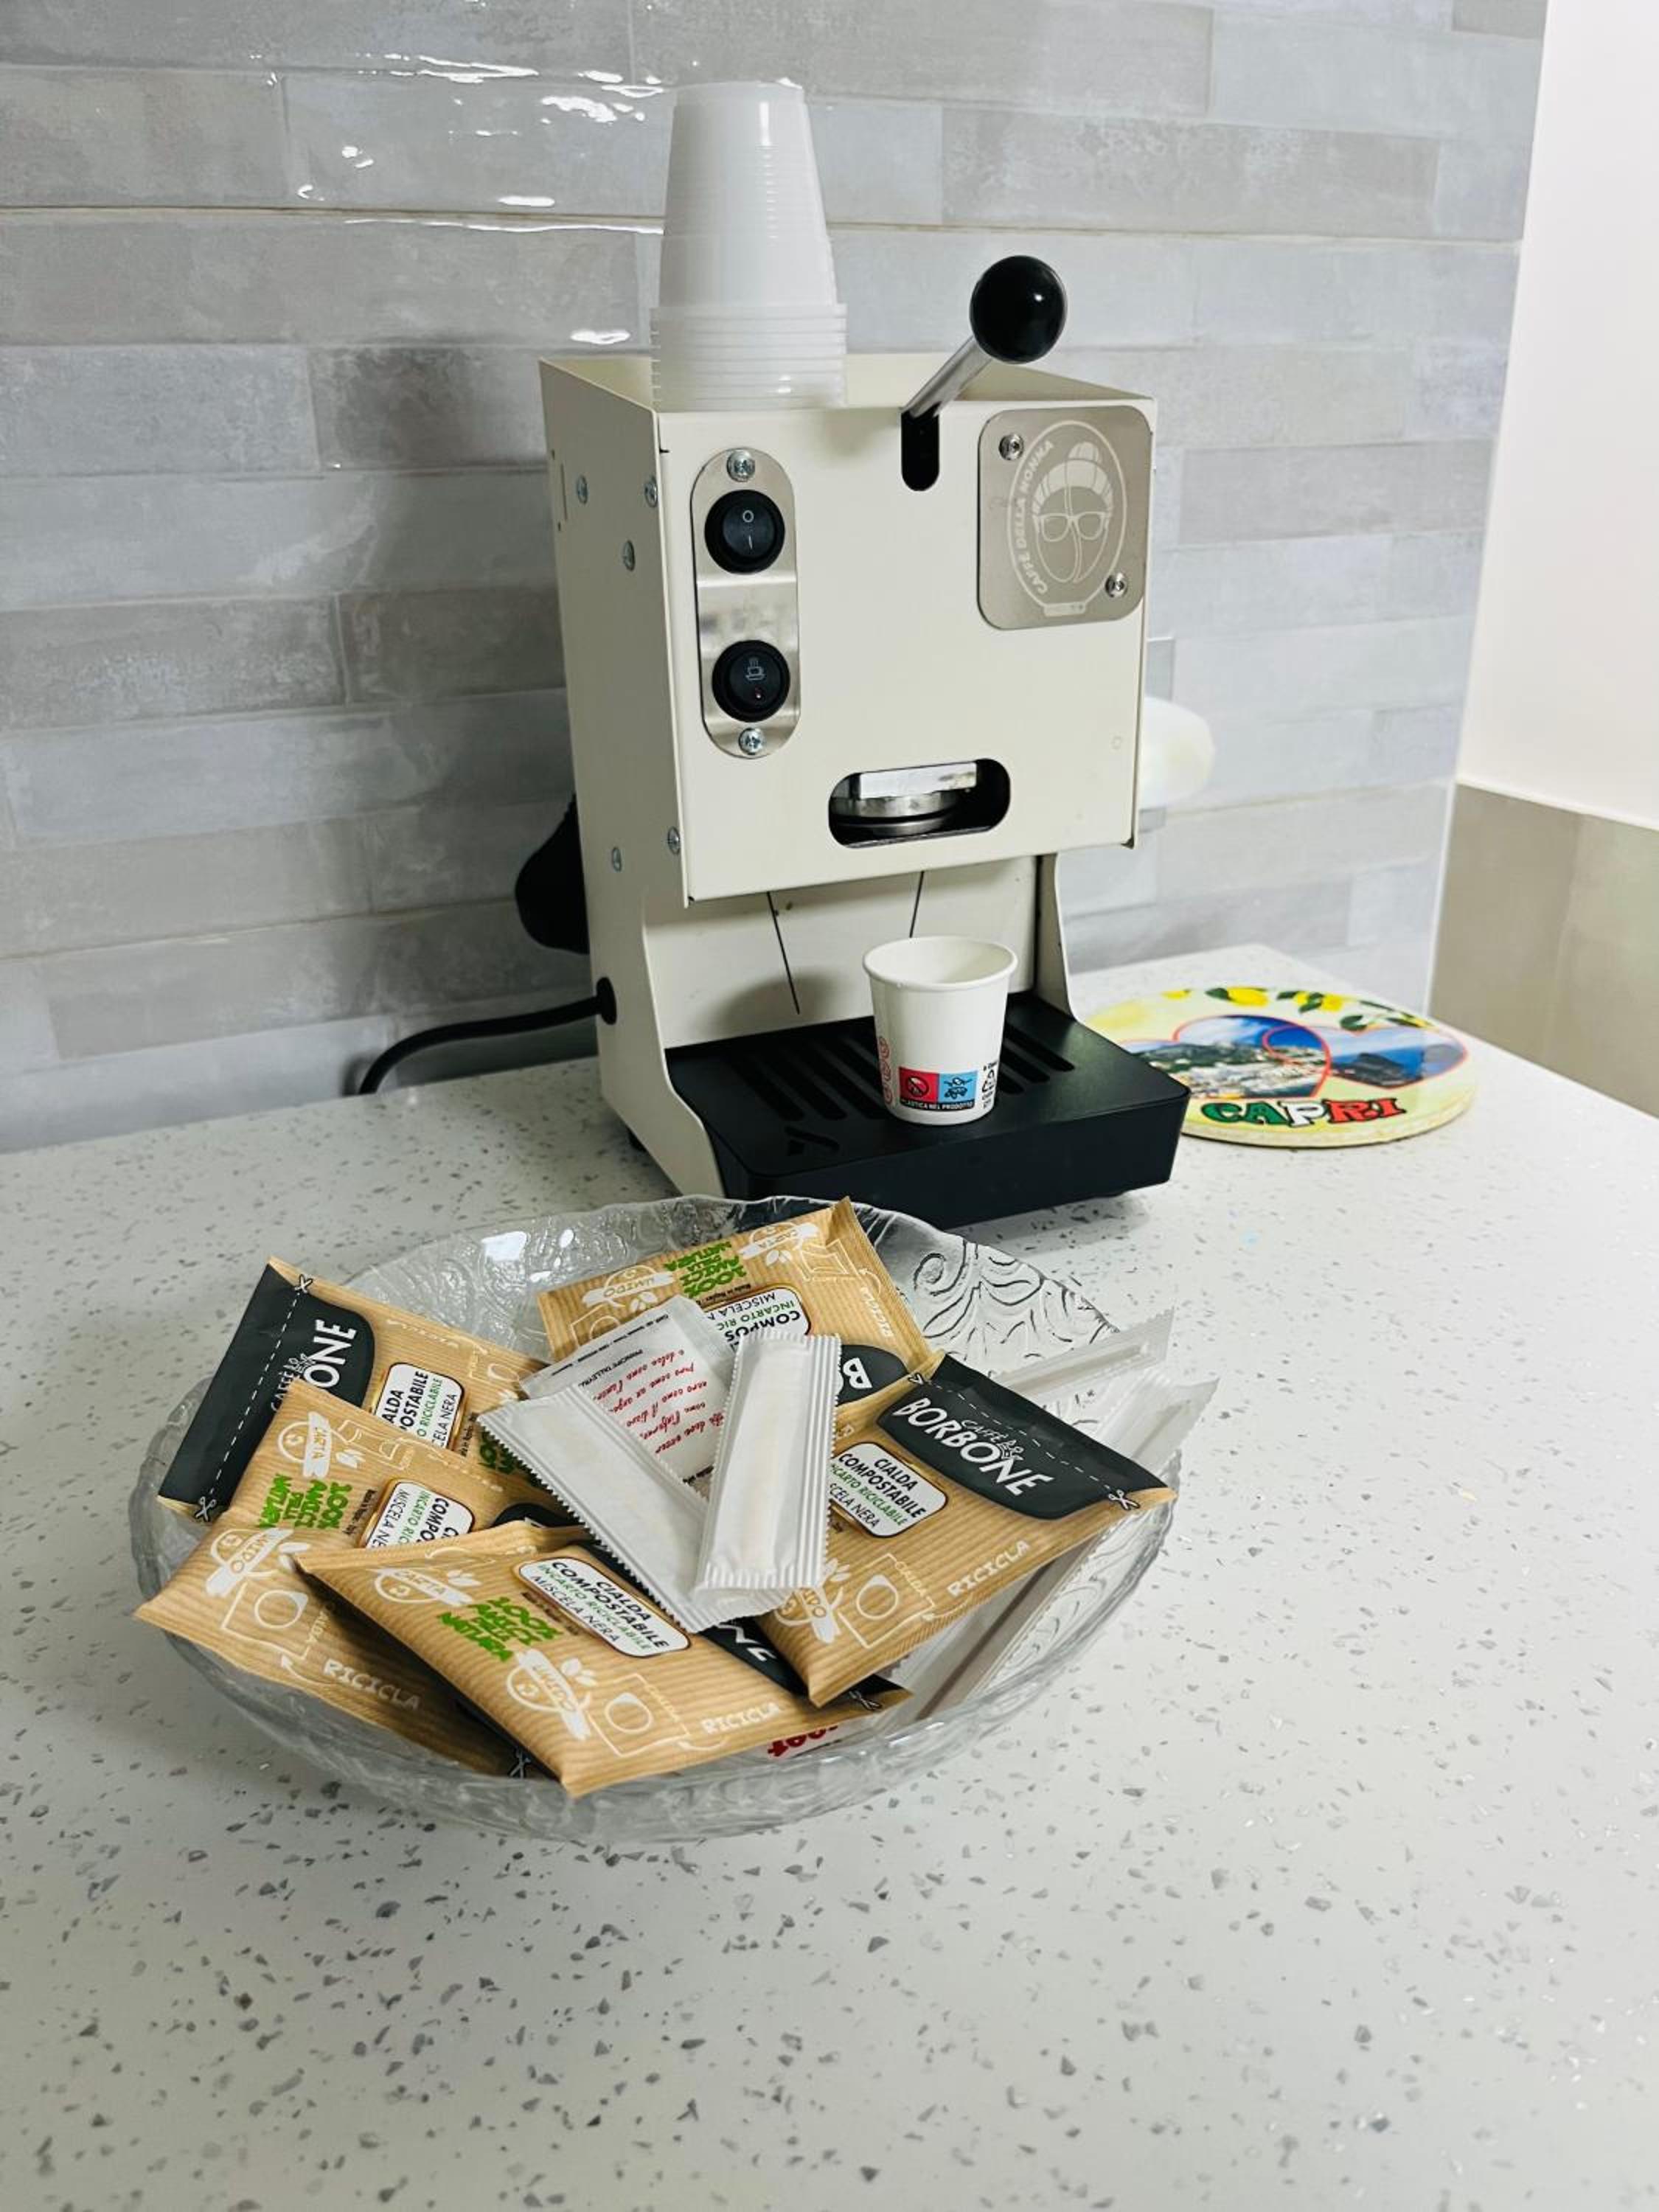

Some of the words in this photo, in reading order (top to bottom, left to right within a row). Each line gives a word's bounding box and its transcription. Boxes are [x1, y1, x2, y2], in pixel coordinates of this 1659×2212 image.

[1019, 440, 1054, 495] NONNA
[1015, 498, 1027, 549] DELLA
[1200, 1098, 1406, 1127] CAPRI
[757, 1228, 799, 1250] CARTA
[601, 1275, 654, 1298] UMIDO
[720, 1292, 776, 1318] MISCELA
[740, 1298, 794, 1323] INCARTO
[399, 1371, 428, 1430] OSTABILE
[441, 1391, 457, 1420] NERA
[894, 1397, 1054, 1497] BORBONE
[838, 1453, 927, 1520] COMPOSTABILE
[874, 1458, 918, 1492] CIALDA
[382, 1489, 408, 1529] MISCELA
[409, 1491, 431, 1526] INCARTO
[420, 1497, 451, 1544] COMPO
[851, 1502, 881, 1528] NERA
[858, 1484, 909, 1527] RICICLABILE
[371, 1529, 390, 1548] NE
[947, 1540, 1032, 1598] RICICLA
[529, 1575, 584, 1618] MISCELA
[581, 1613, 621, 1644] NERA
[552, 1561, 669, 1649] COMPOSTABILE
[596, 1580, 651, 1621] CIALDA
[324, 1660, 422, 1711] RICICLA
[700, 1703, 783, 1734] RICICLA
